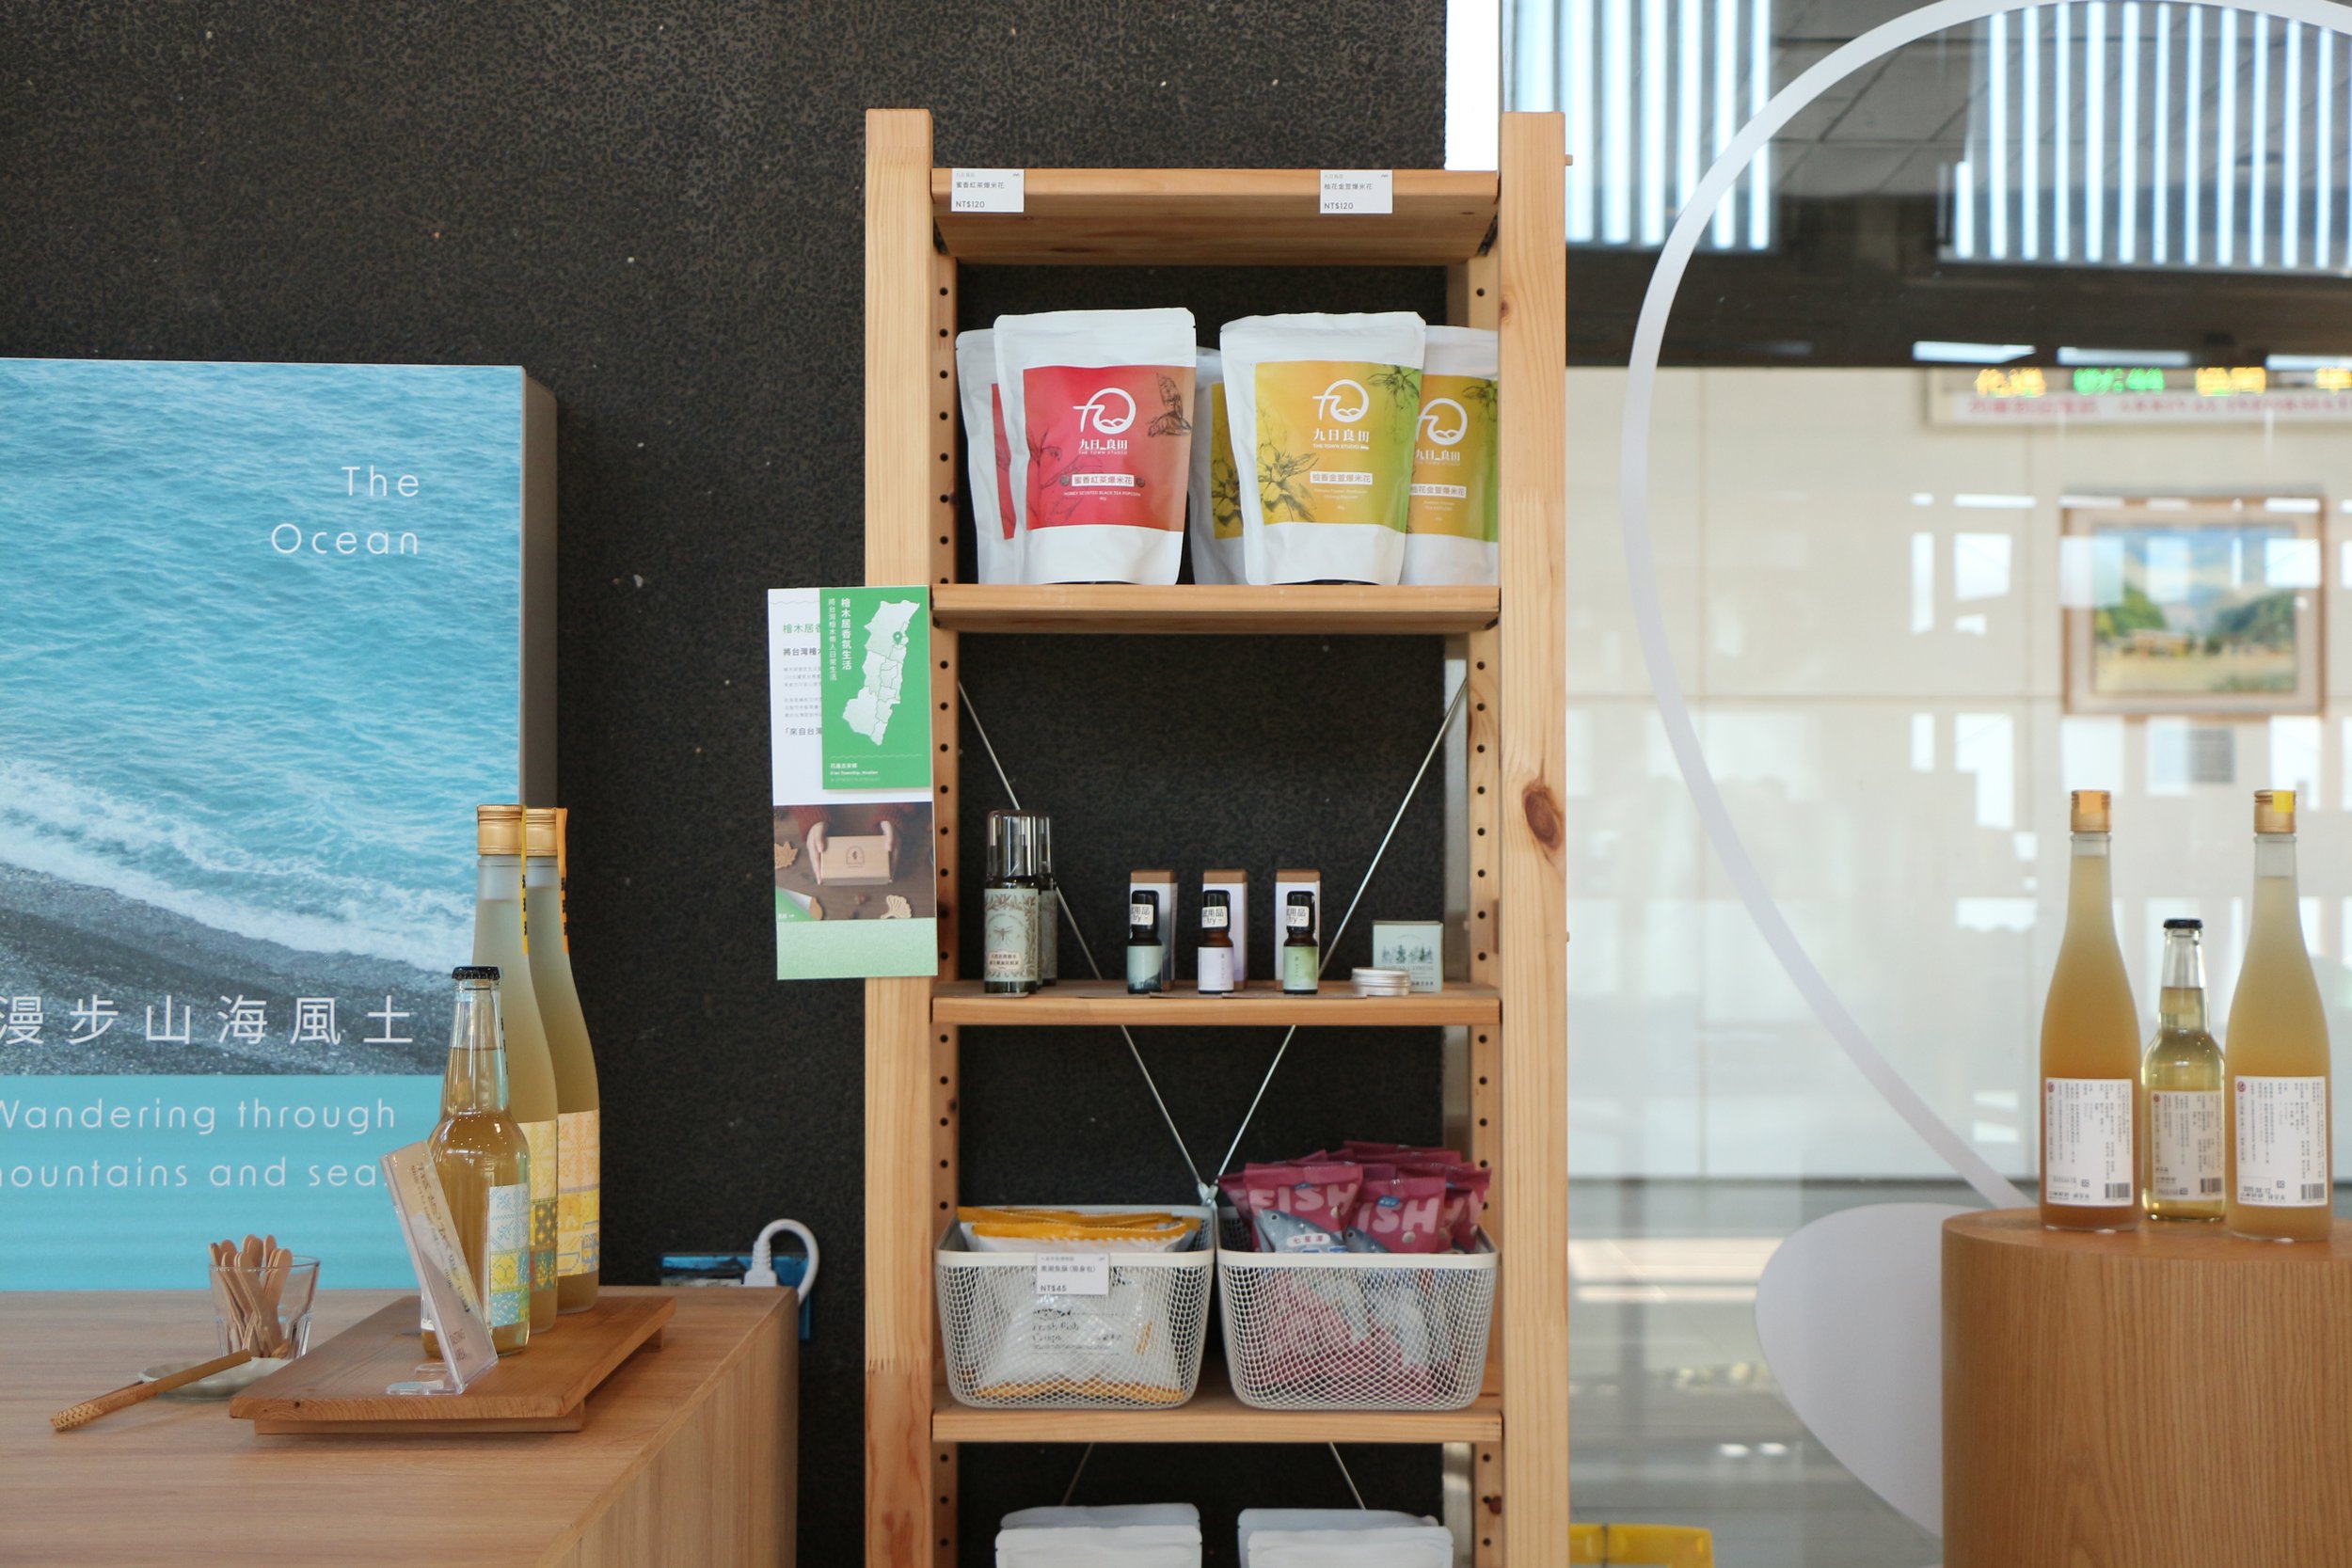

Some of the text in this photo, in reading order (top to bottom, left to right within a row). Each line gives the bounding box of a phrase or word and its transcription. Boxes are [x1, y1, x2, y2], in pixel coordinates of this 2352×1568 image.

[342, 466, 419, 497] The
[271, 523, 419, 555] Ocean
[1131, 907, 1151, 915] 用品
[0, 994, 414, 1045] 漫步山海風土
[238, 1099, 394, 1134] through
[0, 1157, 388, 1187] ountains and sea
[1248, 1182, 1358, 1217] FISH
[1357, 1196, 1440, 1234] ISH
